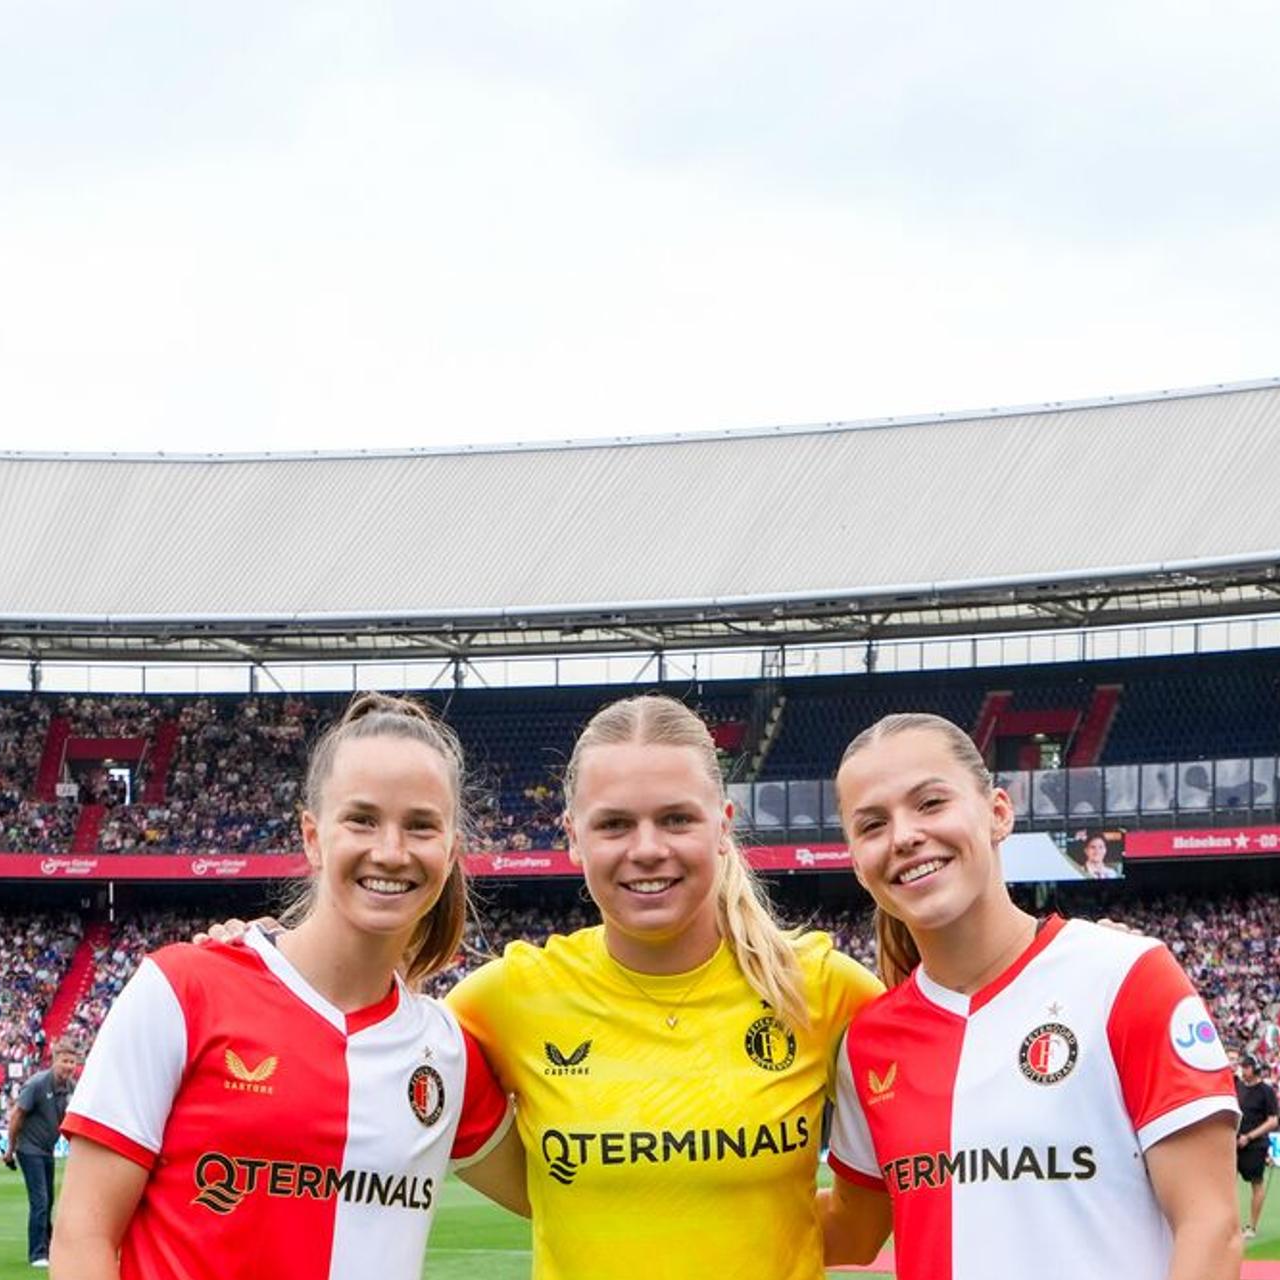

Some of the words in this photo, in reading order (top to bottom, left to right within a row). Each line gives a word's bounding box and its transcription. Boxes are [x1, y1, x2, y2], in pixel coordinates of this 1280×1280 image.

[1173, 835, 1231, 849] Heineken
[542, 1116, 808, 1185] QTERMINALS
[194, 1152, 433, 1214] QTERMINALS
